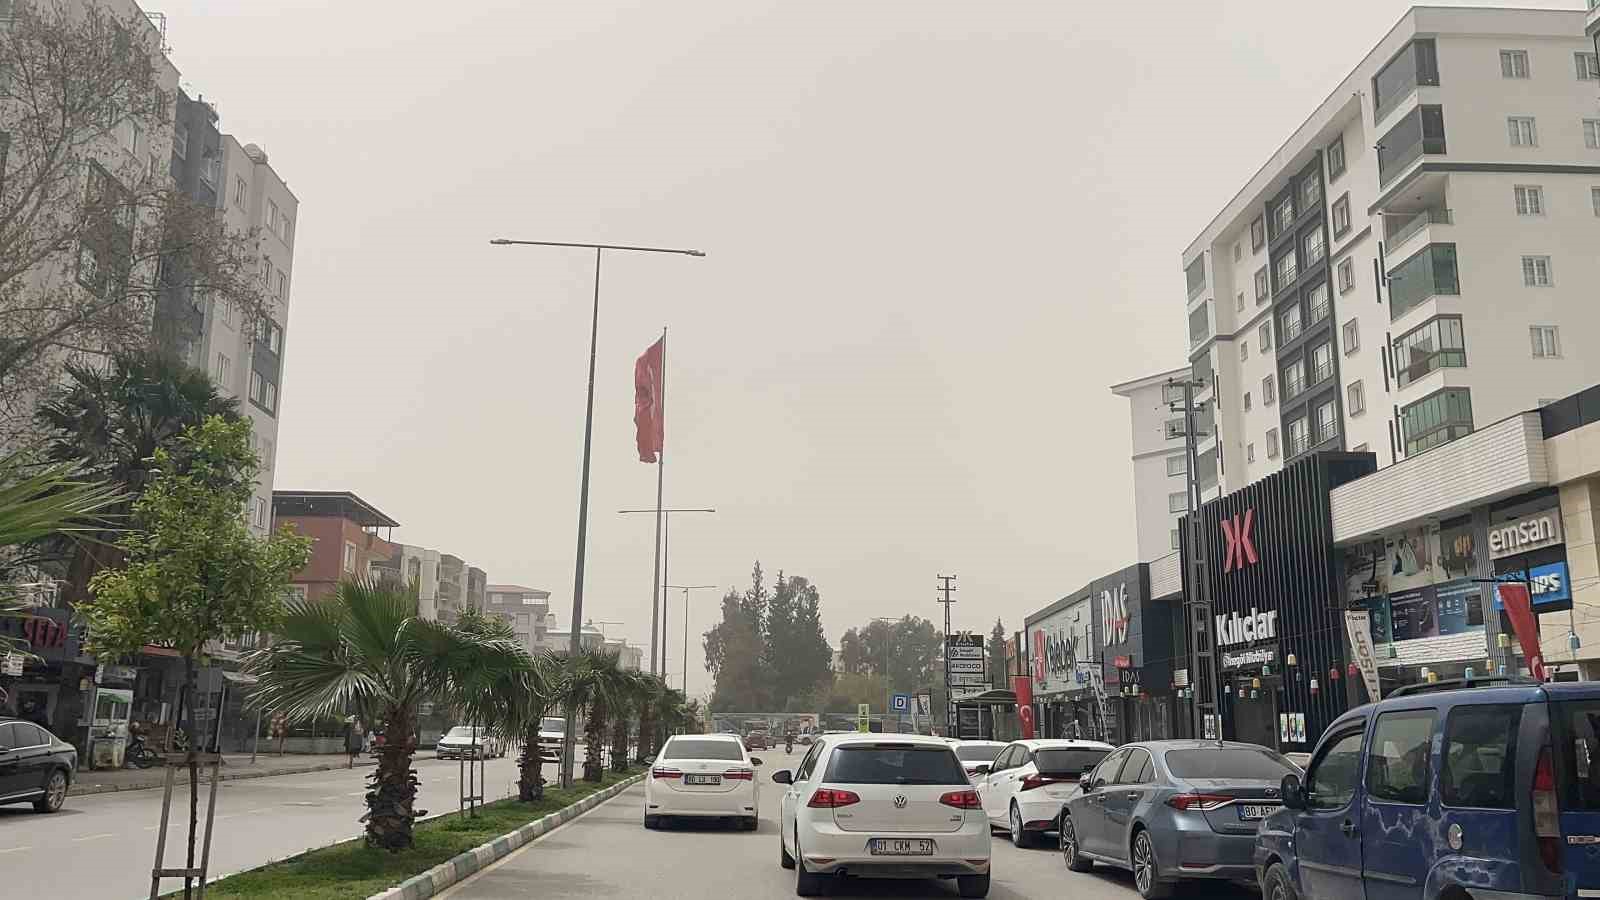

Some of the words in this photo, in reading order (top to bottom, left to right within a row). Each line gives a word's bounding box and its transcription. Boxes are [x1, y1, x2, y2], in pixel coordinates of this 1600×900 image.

[1489, 516, 1553, 552] emsan
[1045, 627, 1079, 674] Kelebek
[894, 840, 911, 851] CKM
[919, 840, 931, 851] 52
